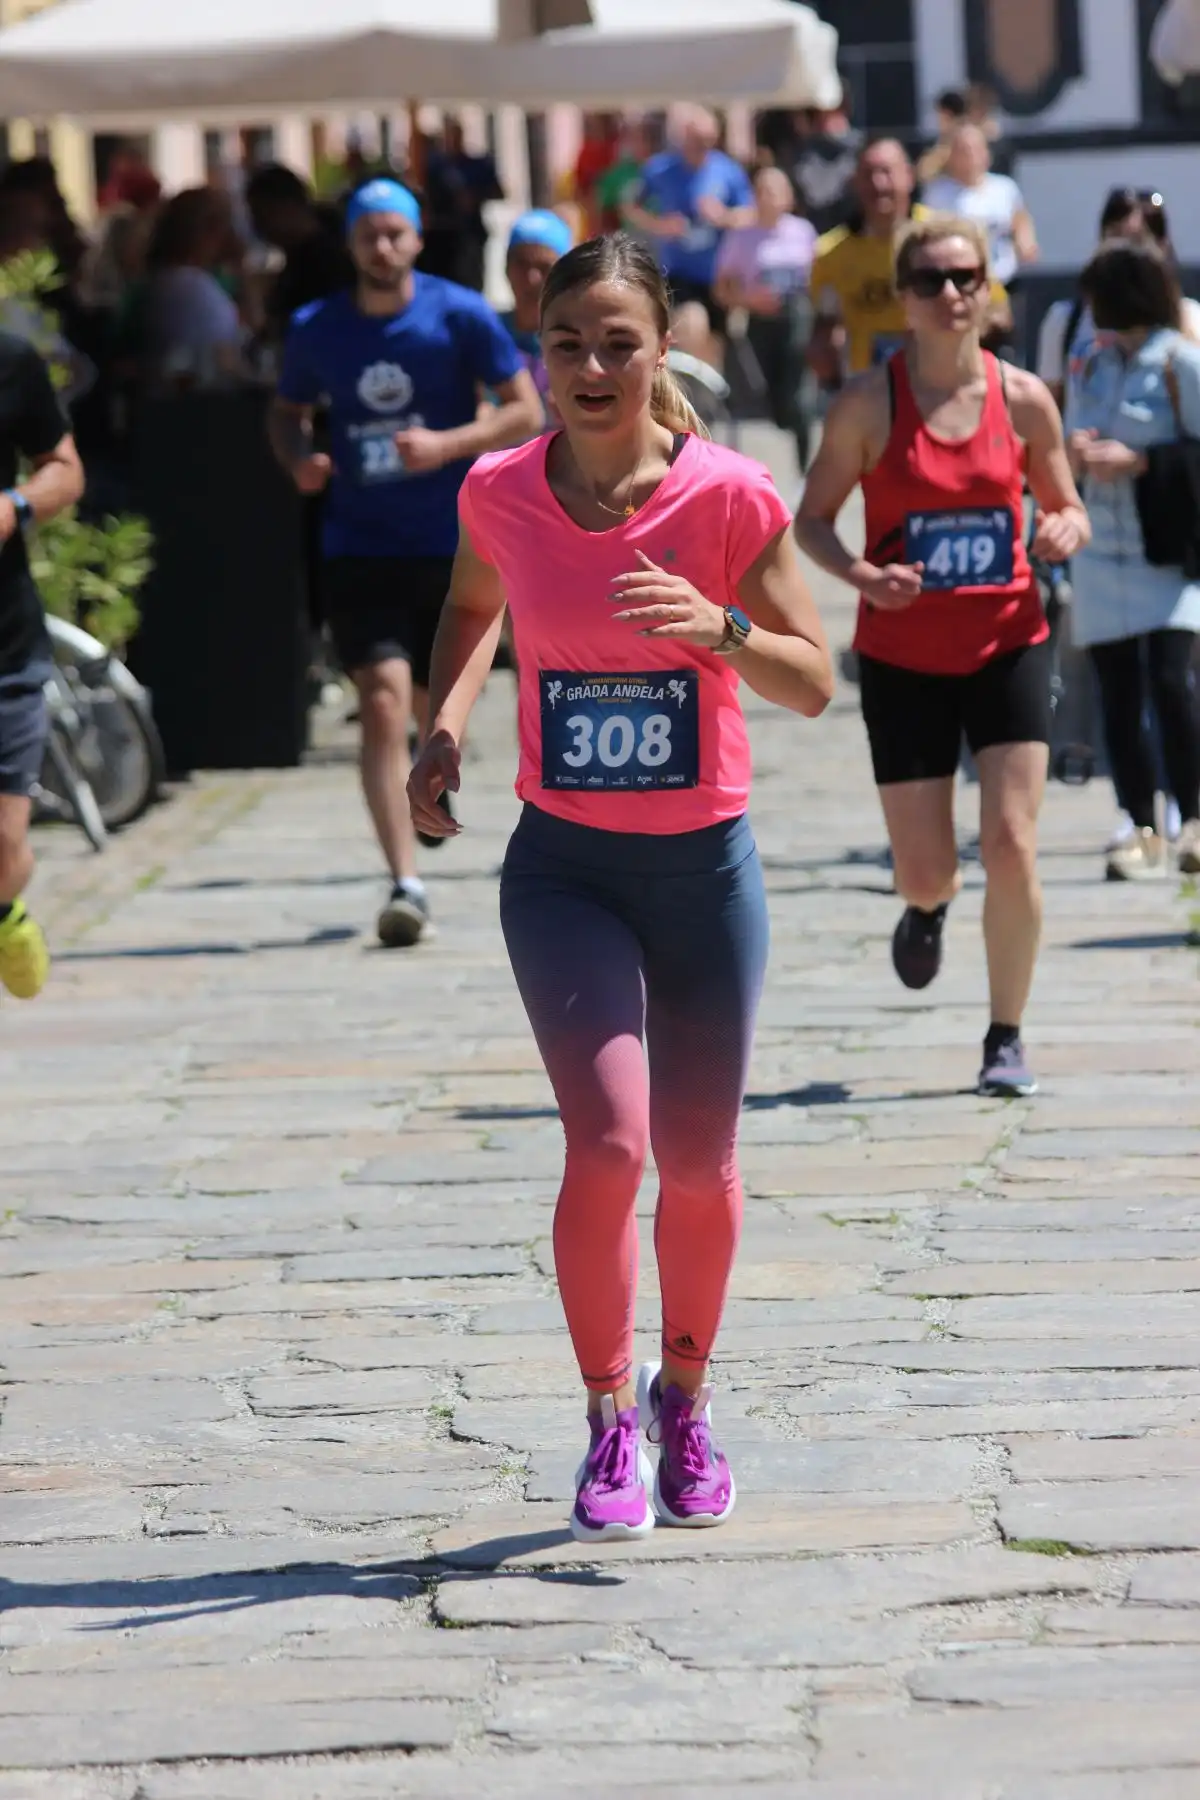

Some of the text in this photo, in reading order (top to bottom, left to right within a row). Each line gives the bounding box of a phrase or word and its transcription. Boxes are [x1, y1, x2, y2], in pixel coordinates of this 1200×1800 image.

[927, 535, 995, 576] 419
[566, 684, 609, 701] GRADA
[612, 684, 664, 700] ANĐELA
[562, 714, 672, 768] 308
